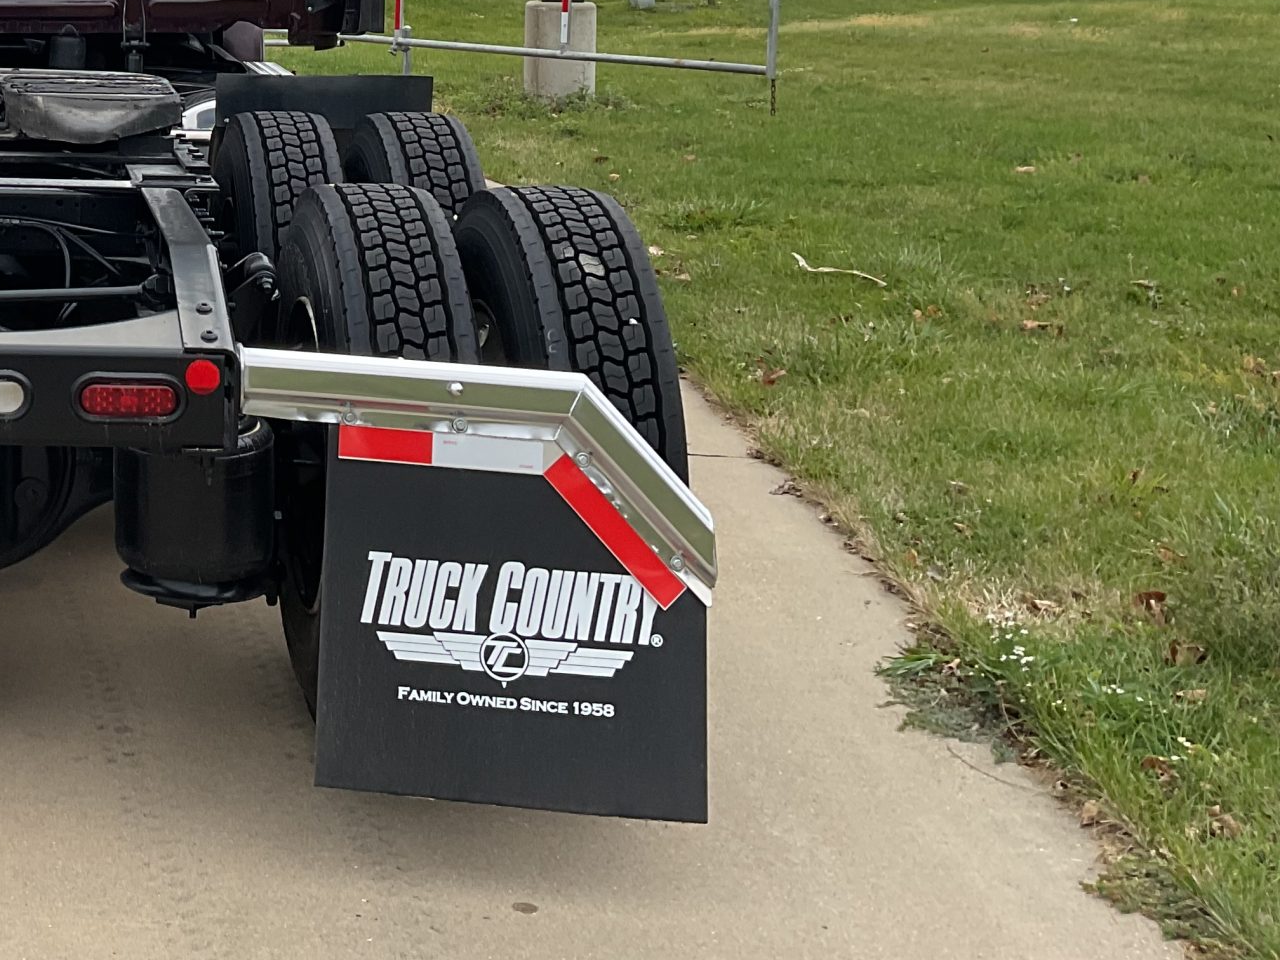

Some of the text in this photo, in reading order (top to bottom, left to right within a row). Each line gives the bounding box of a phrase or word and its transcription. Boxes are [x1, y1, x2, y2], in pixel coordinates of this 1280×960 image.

[360, 551, 488, 632] TRUCK
[397, 686, 615, 718] FAMILY OWNED SINCE 1958
